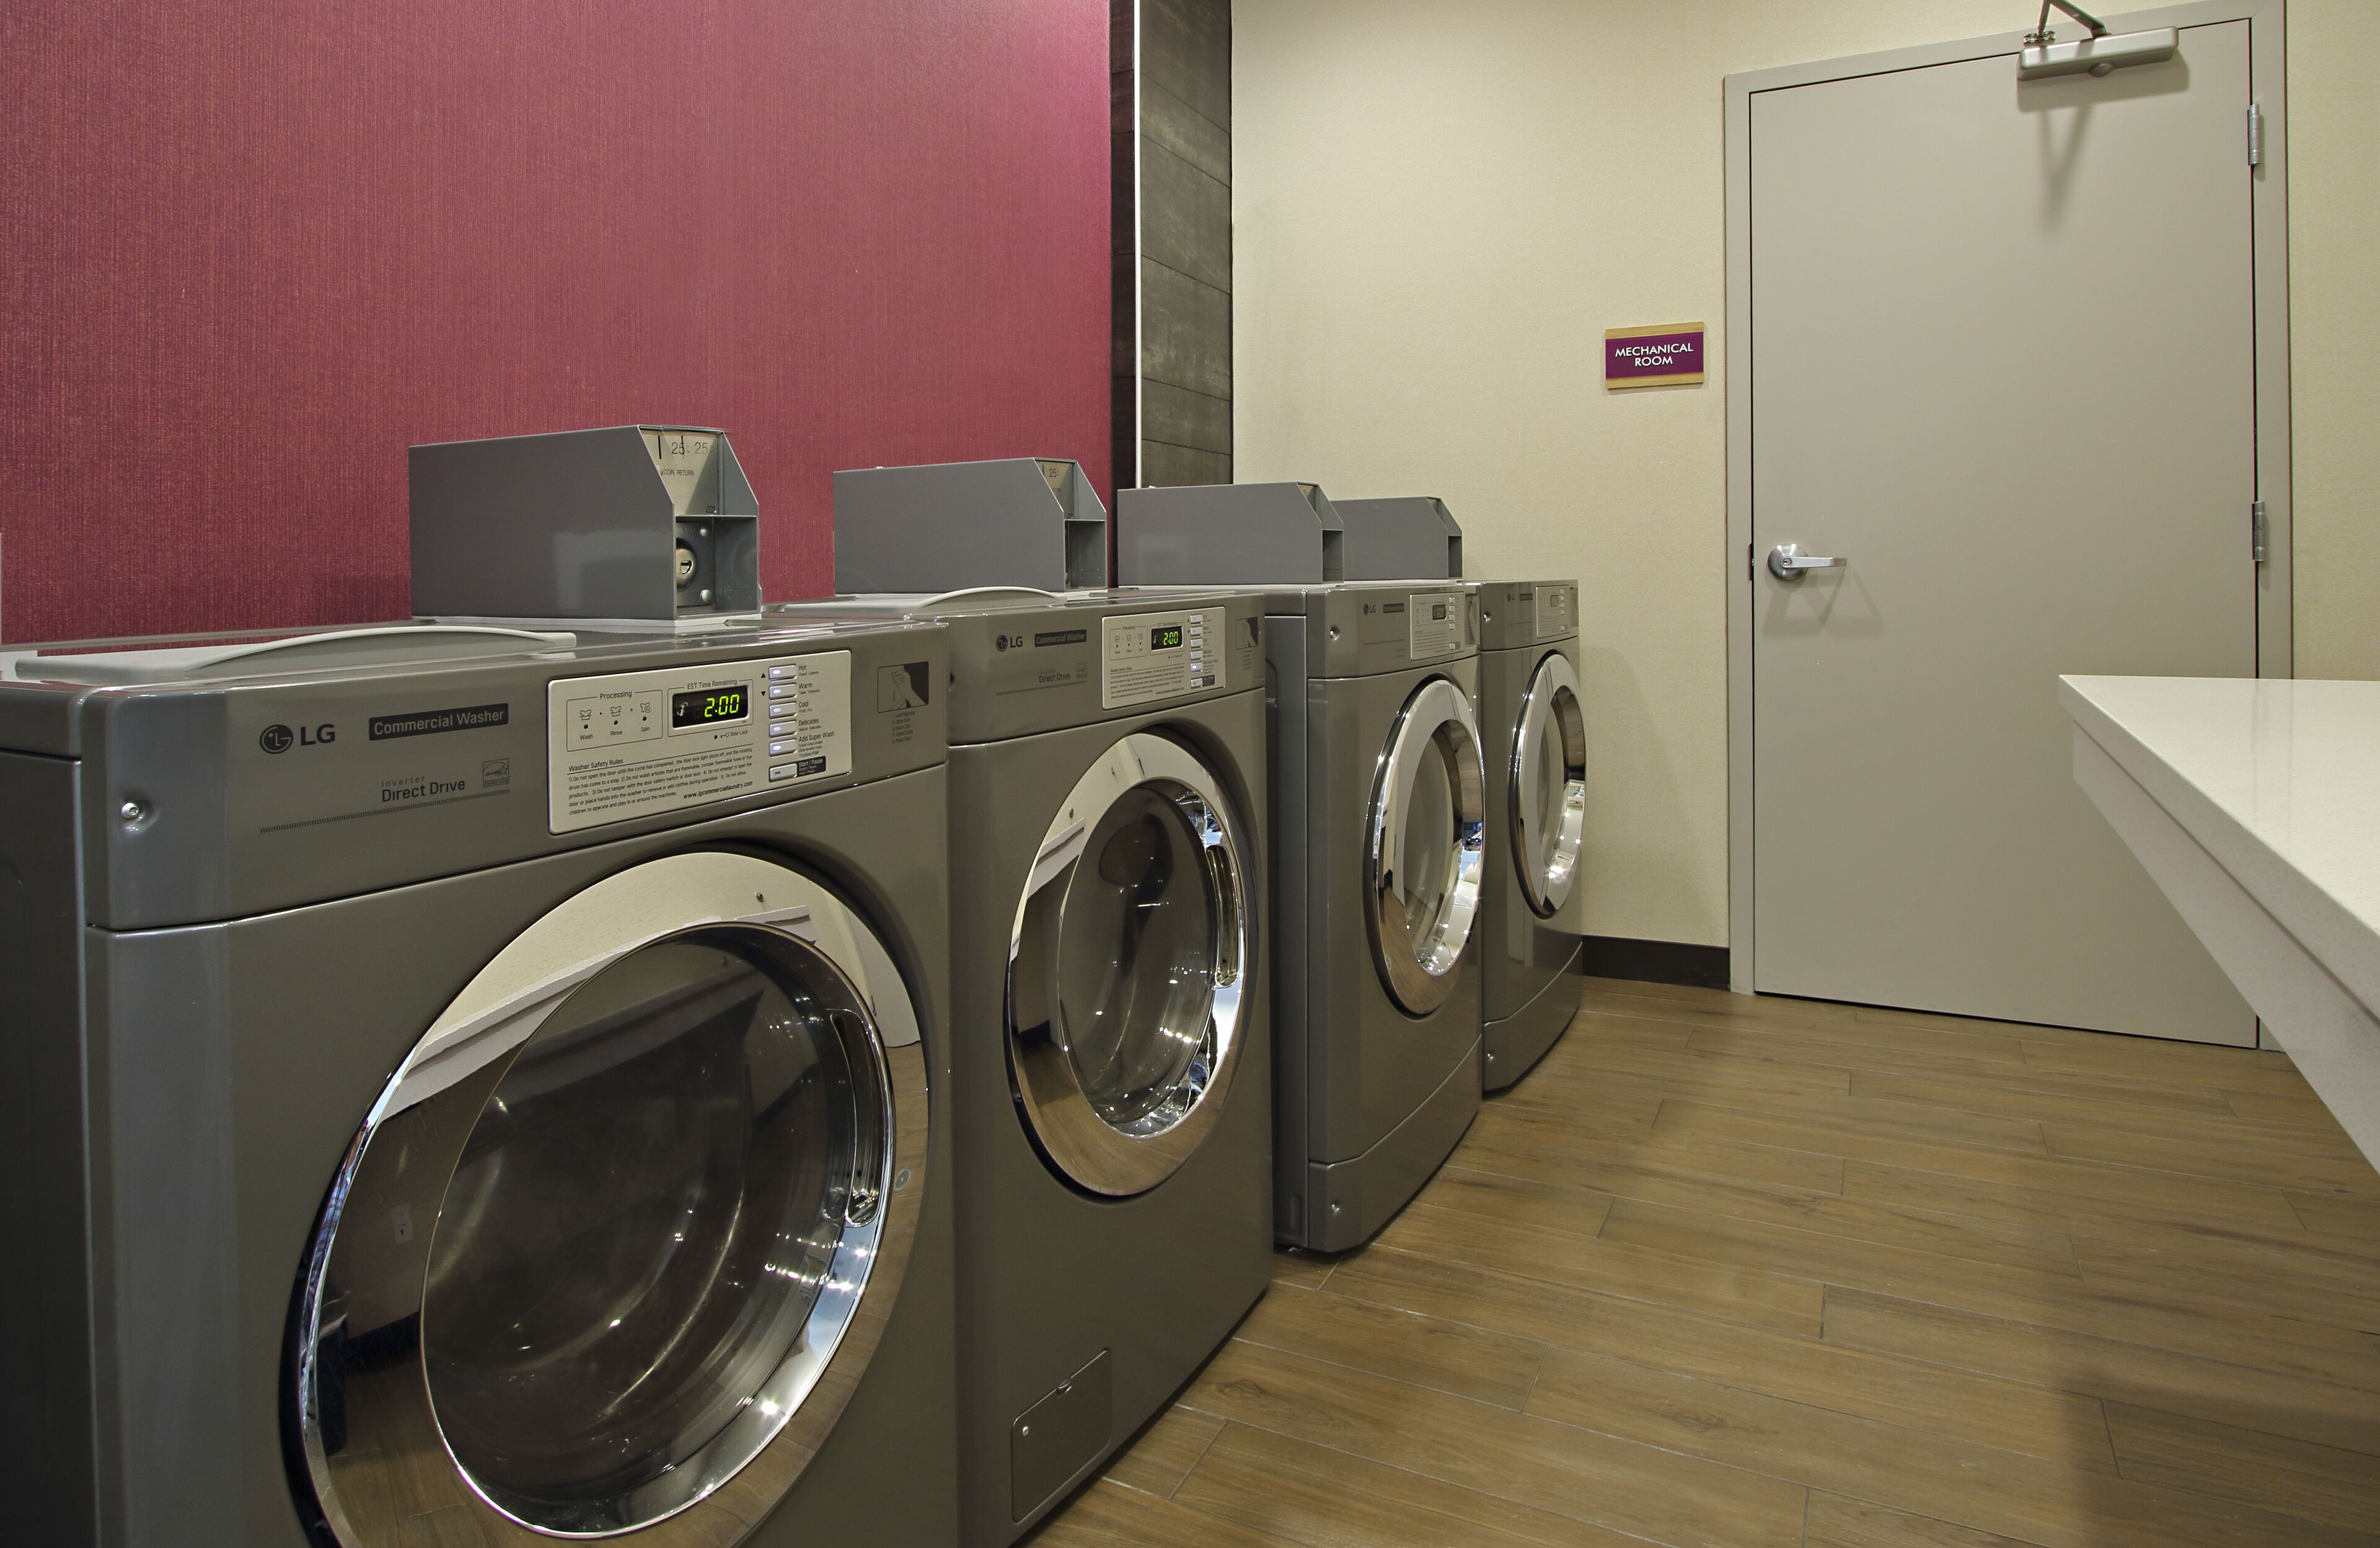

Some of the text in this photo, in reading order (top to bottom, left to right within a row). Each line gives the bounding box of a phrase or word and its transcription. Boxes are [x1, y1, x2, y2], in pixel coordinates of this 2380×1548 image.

[1615, 343, 1693, 357] MECHANICAL
[1635, 356, 1673, 366] ROOM
[1370, 605, 1375, 613] LG
[1010, 636, 1023, 648] LG
[1036, 633, 1085, 644] Commercial Washer
[1039, 674, 1056, 683] Direct
[1057, 673, 1070, 681] Drive
[600, 691, 632, 699] Processing
[374, 709, 505, 736] Commercial Washer
[300, 723, 336, 746] LG
[382, 776, 425, 787] Inverter
[382, 784, 425, 802] Direct
[430, 780, 465, 795] Drive
[684, 781, 752, 798] www.lgcommerciallaundry.com
